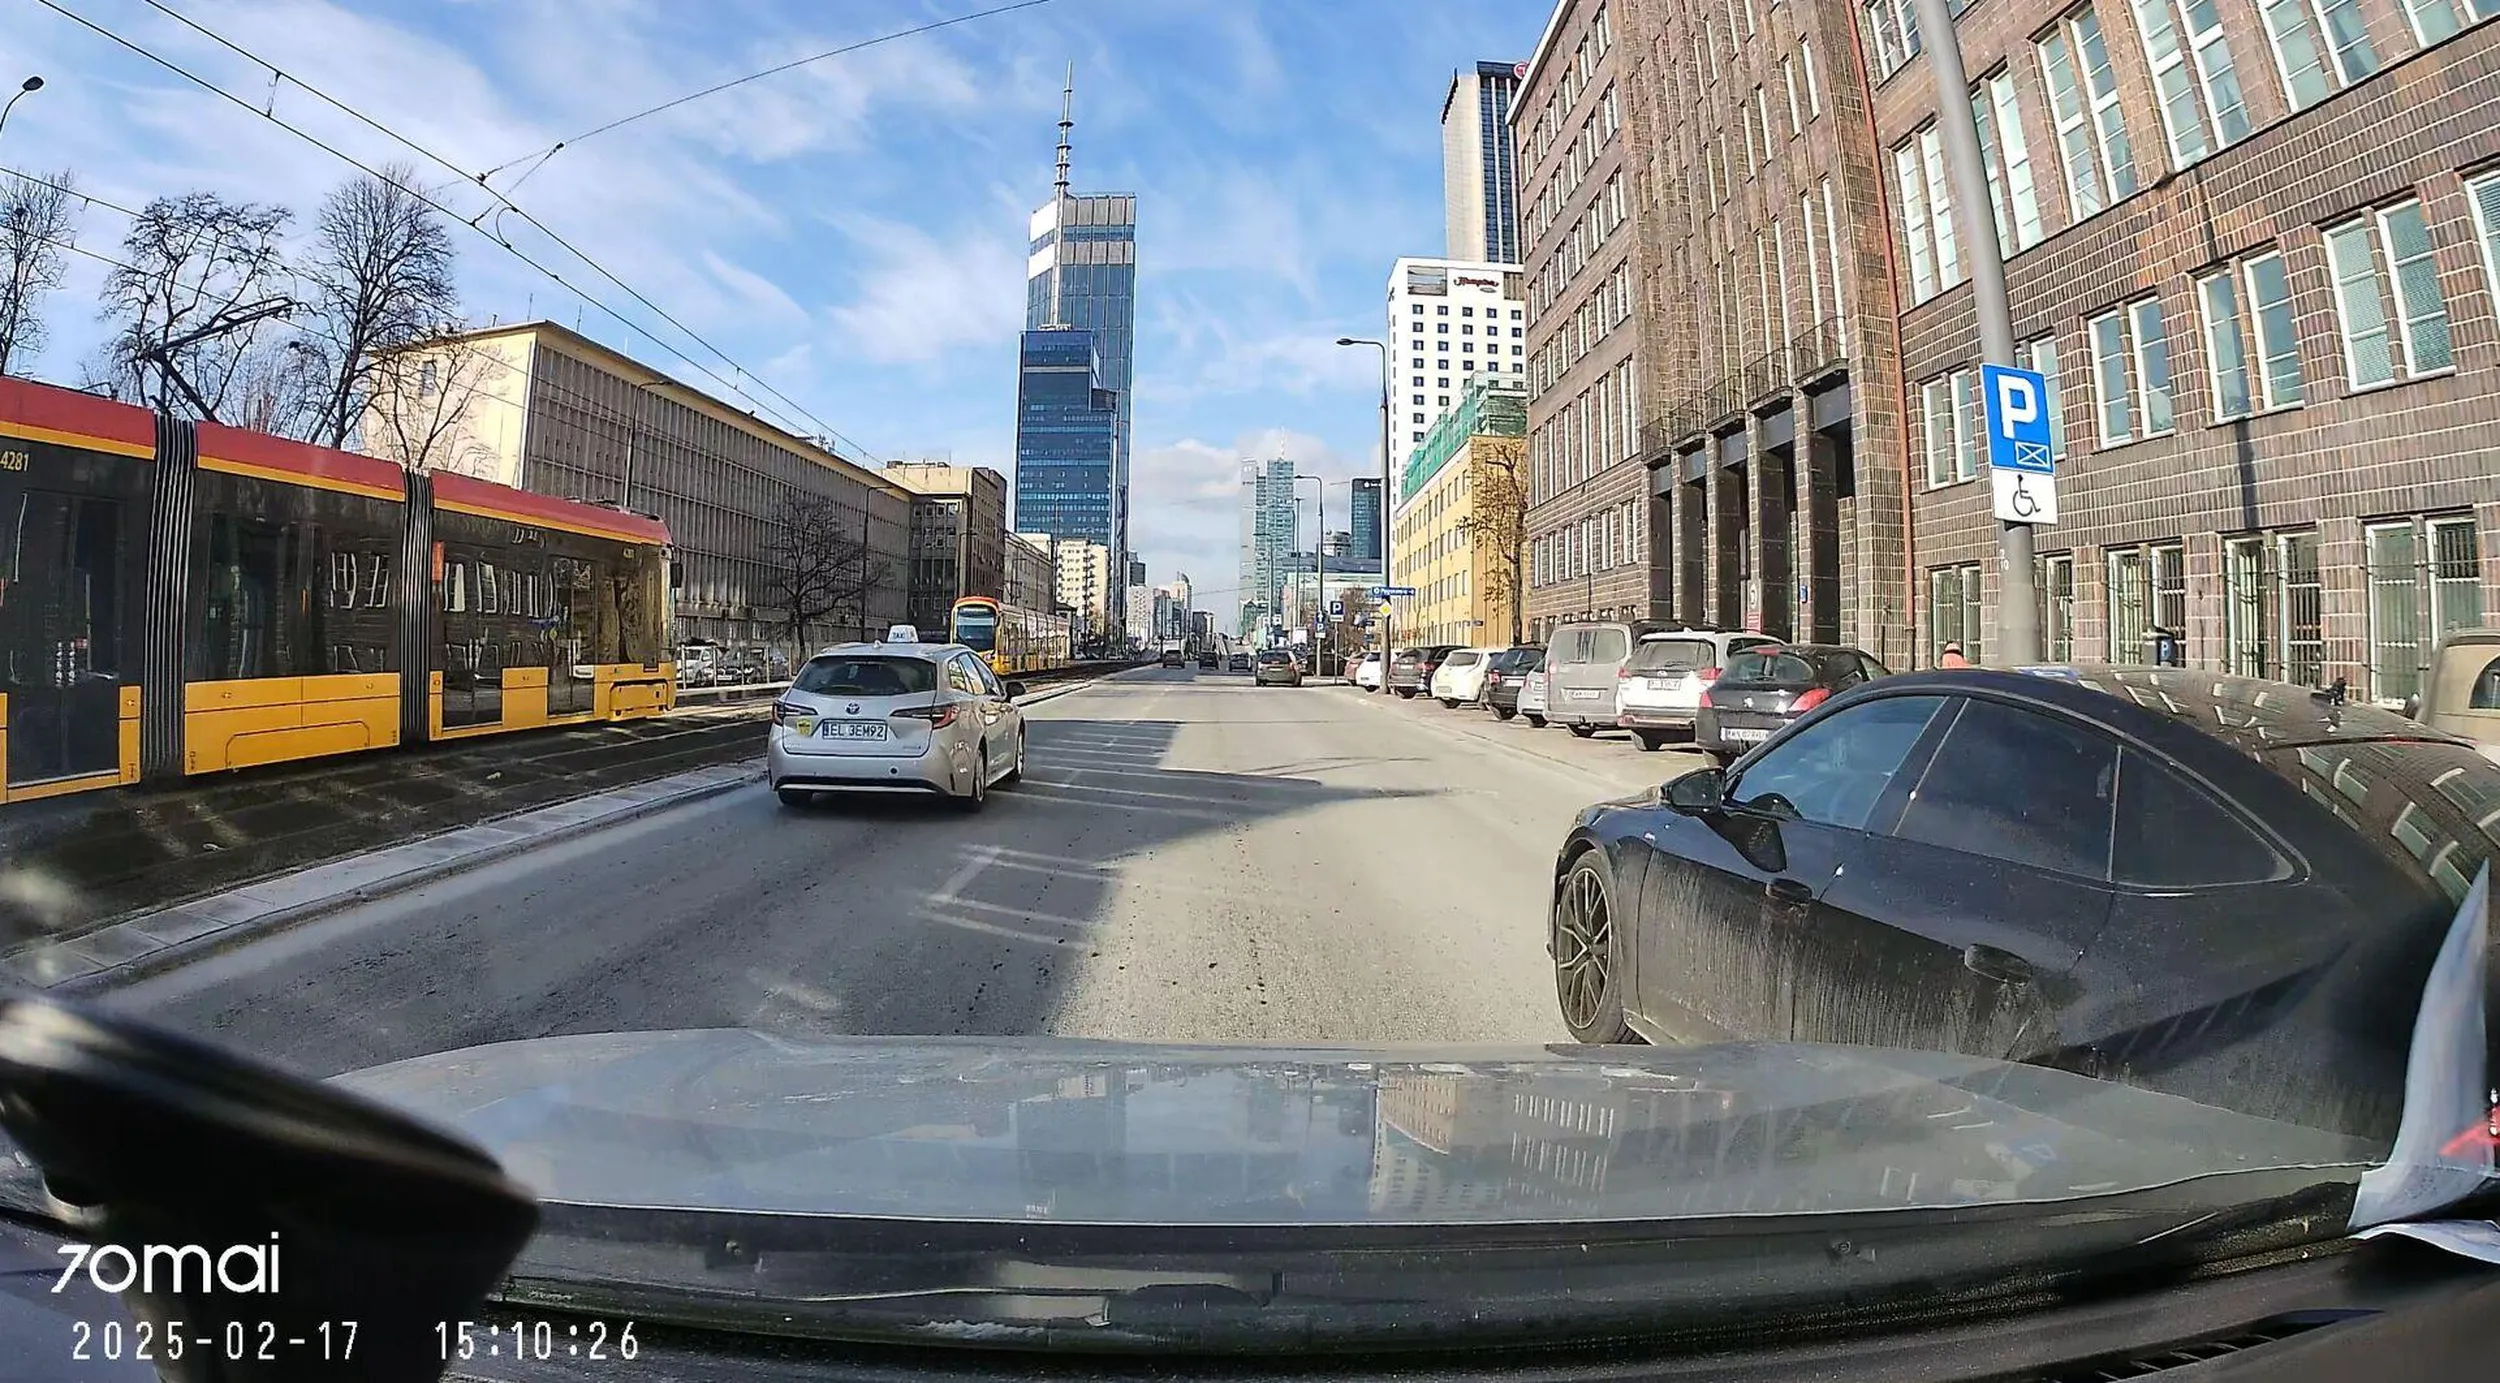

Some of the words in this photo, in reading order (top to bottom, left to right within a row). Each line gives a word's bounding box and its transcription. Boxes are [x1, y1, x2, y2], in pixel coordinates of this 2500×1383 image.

[1997, 374, 2037, 440] P
[0, 450, 29, 472] 4281
[1332, 602, 1342, 614] P
[831, 723, 845, 737] EL
